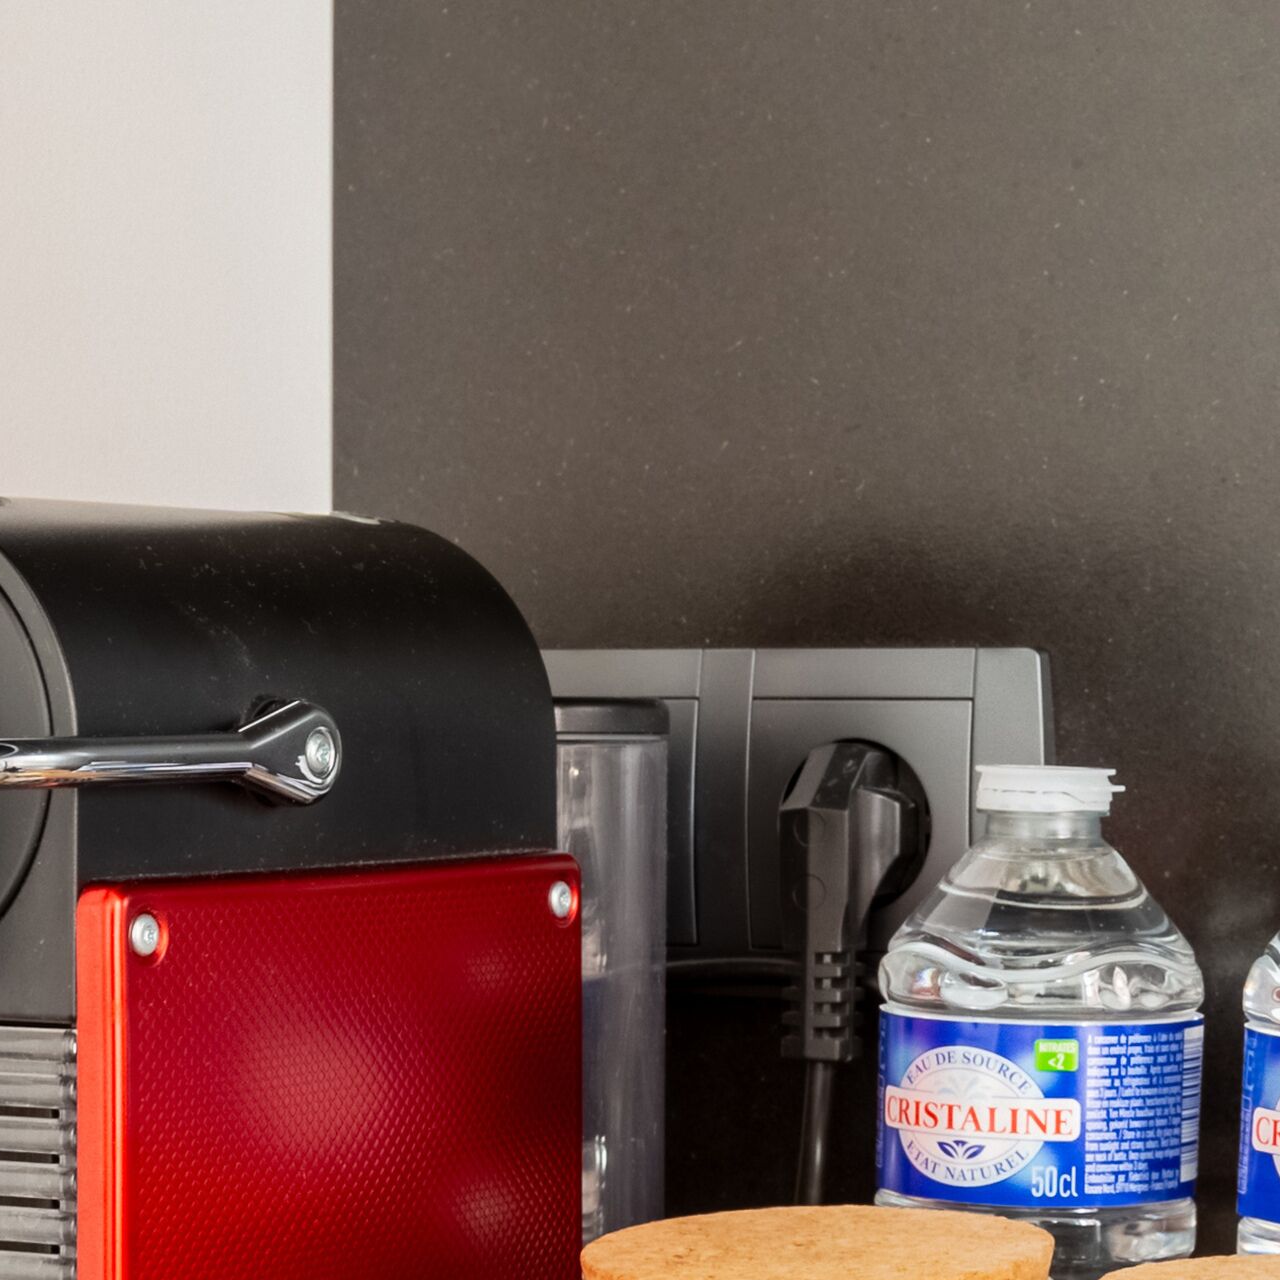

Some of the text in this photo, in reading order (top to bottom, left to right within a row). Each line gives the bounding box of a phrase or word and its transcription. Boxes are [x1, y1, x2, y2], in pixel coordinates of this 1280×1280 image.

[906, 1051, 1032, 1096] EAU DE SOURCE
[885, 1094, 1073, 1136] CRISTALINE
[944, 1149, 1030, 1182] NATUREL
[1031, 1166, 1078, 1198] 50cl
